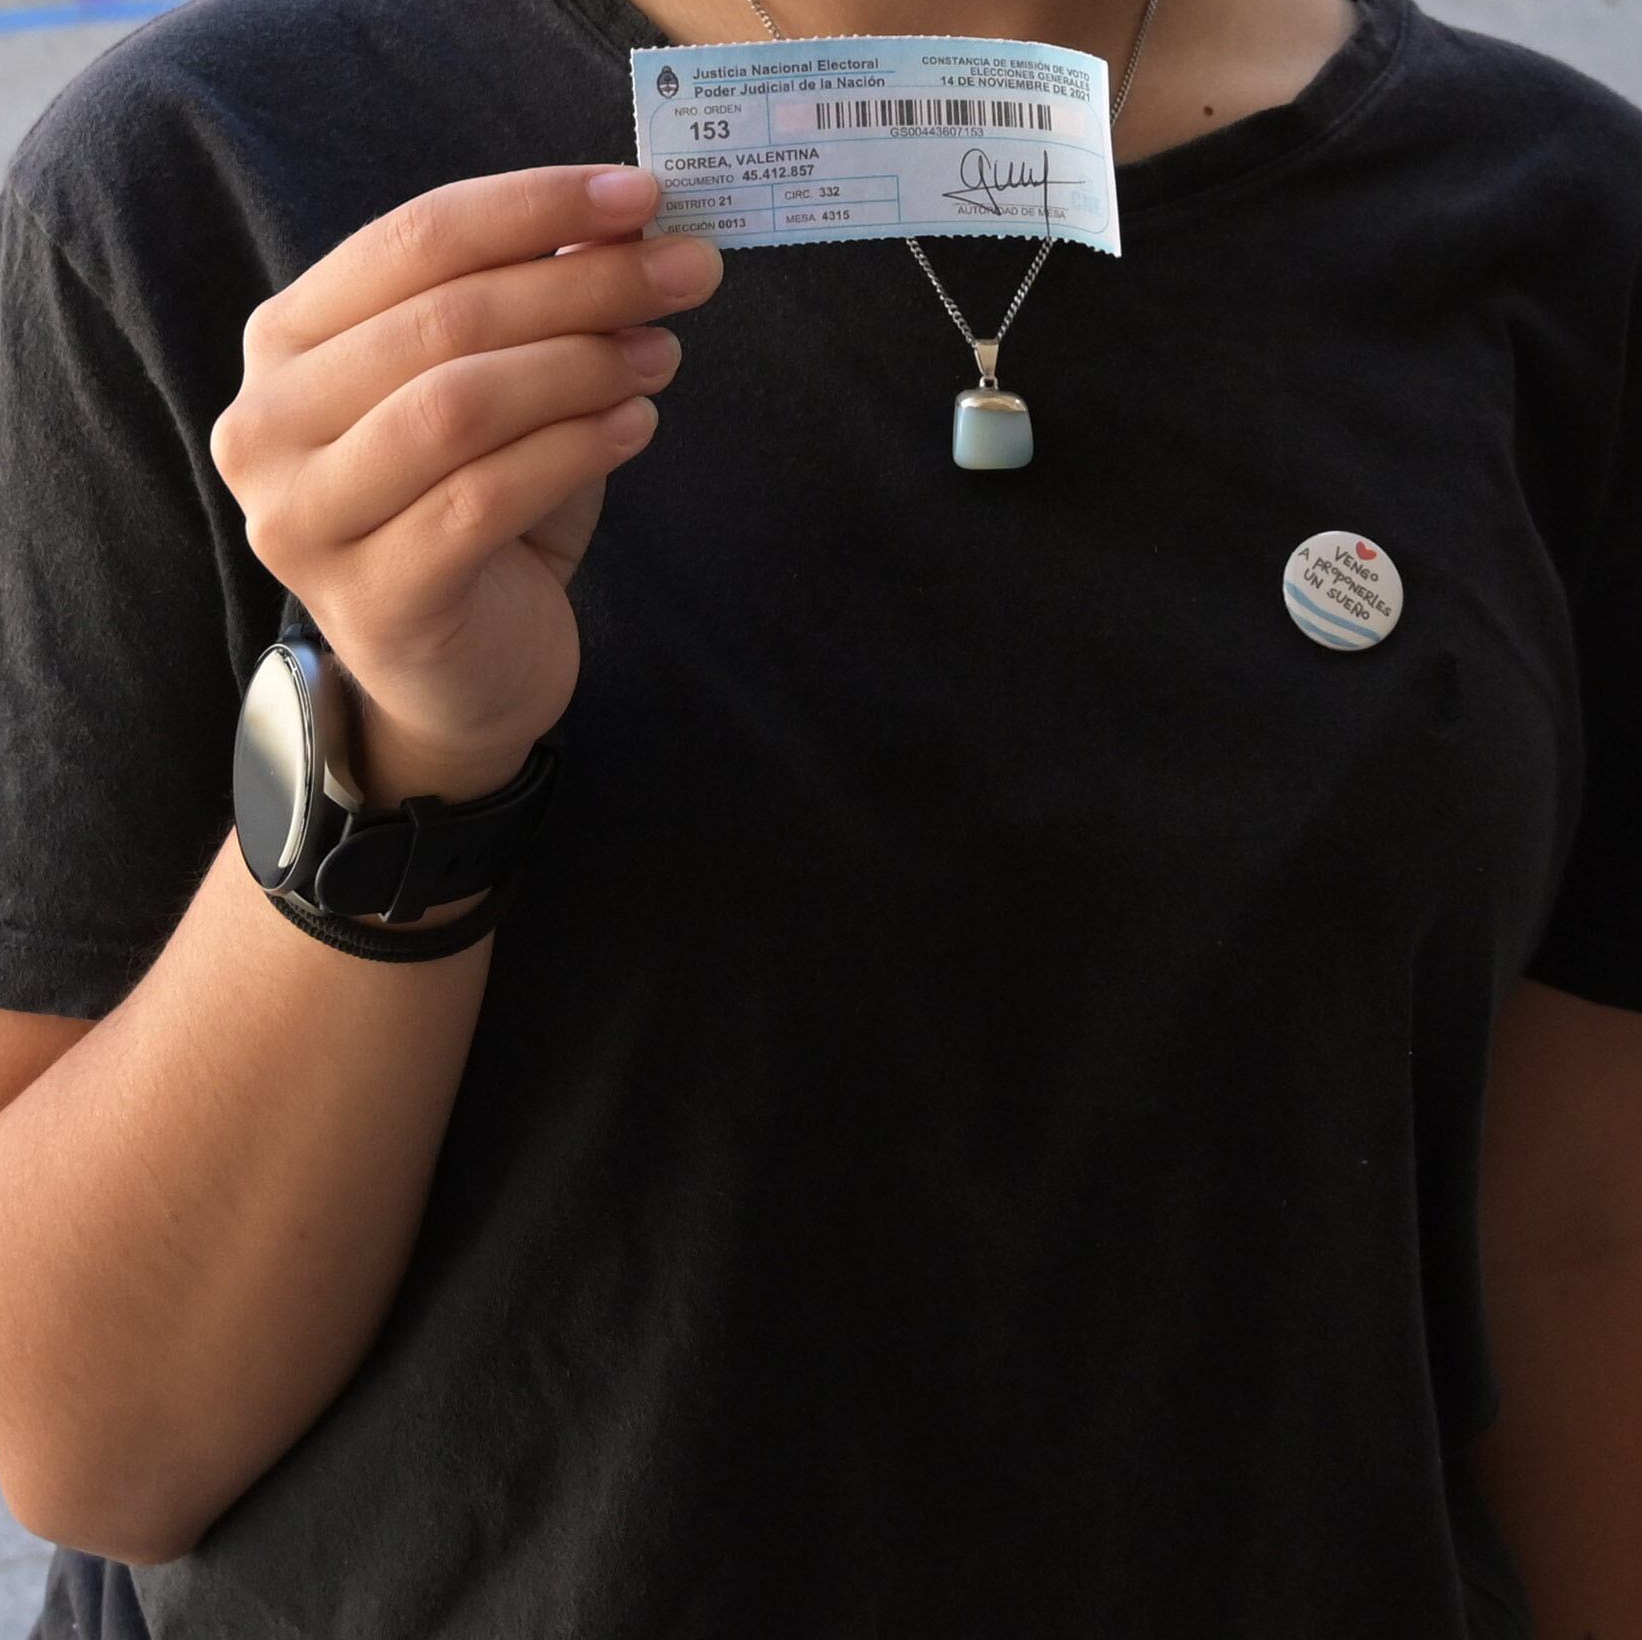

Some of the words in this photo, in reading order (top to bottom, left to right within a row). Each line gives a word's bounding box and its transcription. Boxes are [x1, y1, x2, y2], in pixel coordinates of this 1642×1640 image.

[693, 66, 747, 80] Justicia
[752, 61, 813, 76] Nacional
[817, 58, 879, 71] Electoral
[922, 56, 990, 67] CONSTANCIA
[993, 58, 1007, 67] DE
[1052, 65, 1065, 75] DE
[1067, 69, 1090, 81] VOTO
[970, 66, 1035, 79] ELECCIONES
[1038, 73, 1090, 91] GENERALES
[695, 85, 736, 98] Poder
[740, 80, 794, 95] Judicial
[799, 78, 816, 91] de
[820, 77, 832, 90] la
[837, 76, 885, 89] Nación
[940, 76, 954, 86] 14
[958, 76, 974, 87] DE
[978, 77, 1050, 92] NOVIEMBRE
[1053, 84, 1067, 96] DE
[1070, 87, 1091, 102] 2021
[703, 104, 742, 116] ORDEN
[690, 120, 730, 141] 153
[664, 156, 732, 171] CORREA,
[736, 148, 820, 166] VALENTINA
[665, 175, 734, 188] DOCUMENTO
[742, 164, 815, 182] 45.412.857
[819, 186, 840, 198] 332
[666, 199, 716, 212] DISTRITO
[718, 195, 733, 207] 21
[1021, 207, 1035, 217] DE
[718, 218, 746, 230] 0013
[786, 213, 816, 225] MESA
[821, 210, 850, 221] 4315
[1298, 547, 1310, 561] A
[1335, 546, 1379, 582] VENGO
[1303, 568, 1324, 590] UN
[1326, 588, 1371, 620] SUEÑO
